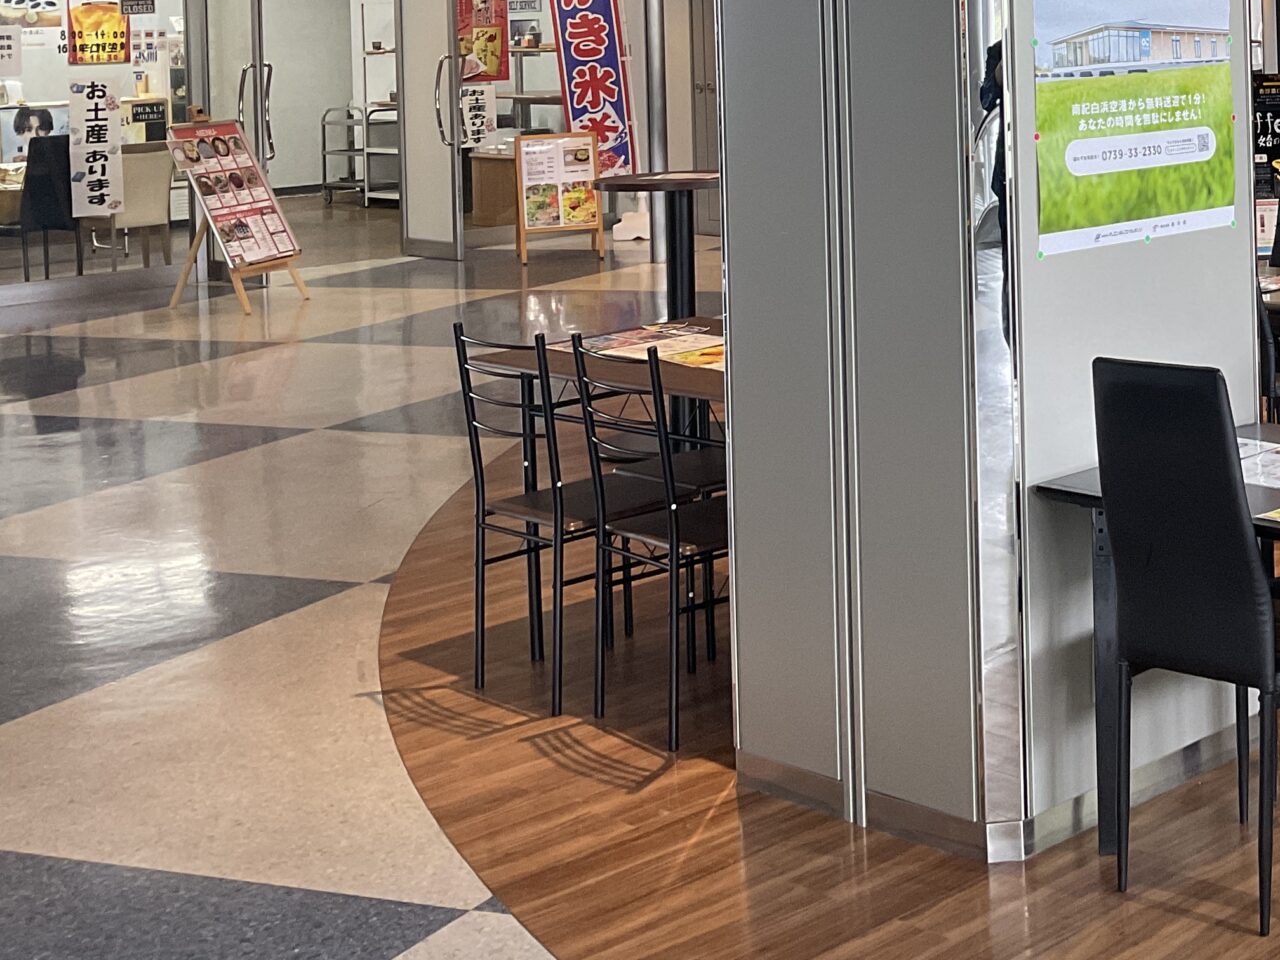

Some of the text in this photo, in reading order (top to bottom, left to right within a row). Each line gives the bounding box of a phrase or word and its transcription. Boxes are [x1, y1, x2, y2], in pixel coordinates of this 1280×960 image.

[123, 5, 154, 14] CLOSED
[133, 106, 151, 114] PICK
[1071, 93, 1206, 116] 南紀白浜空港から無料送迎で1分!
[468, 89, 488, 144] お土産あります
[1078, 108, 1202, 132] あなたの時間を無駄にしません!
[84, 81, 111, 207] お土産あります
[1101, 144, 1162, 161] 0739-33-2330
